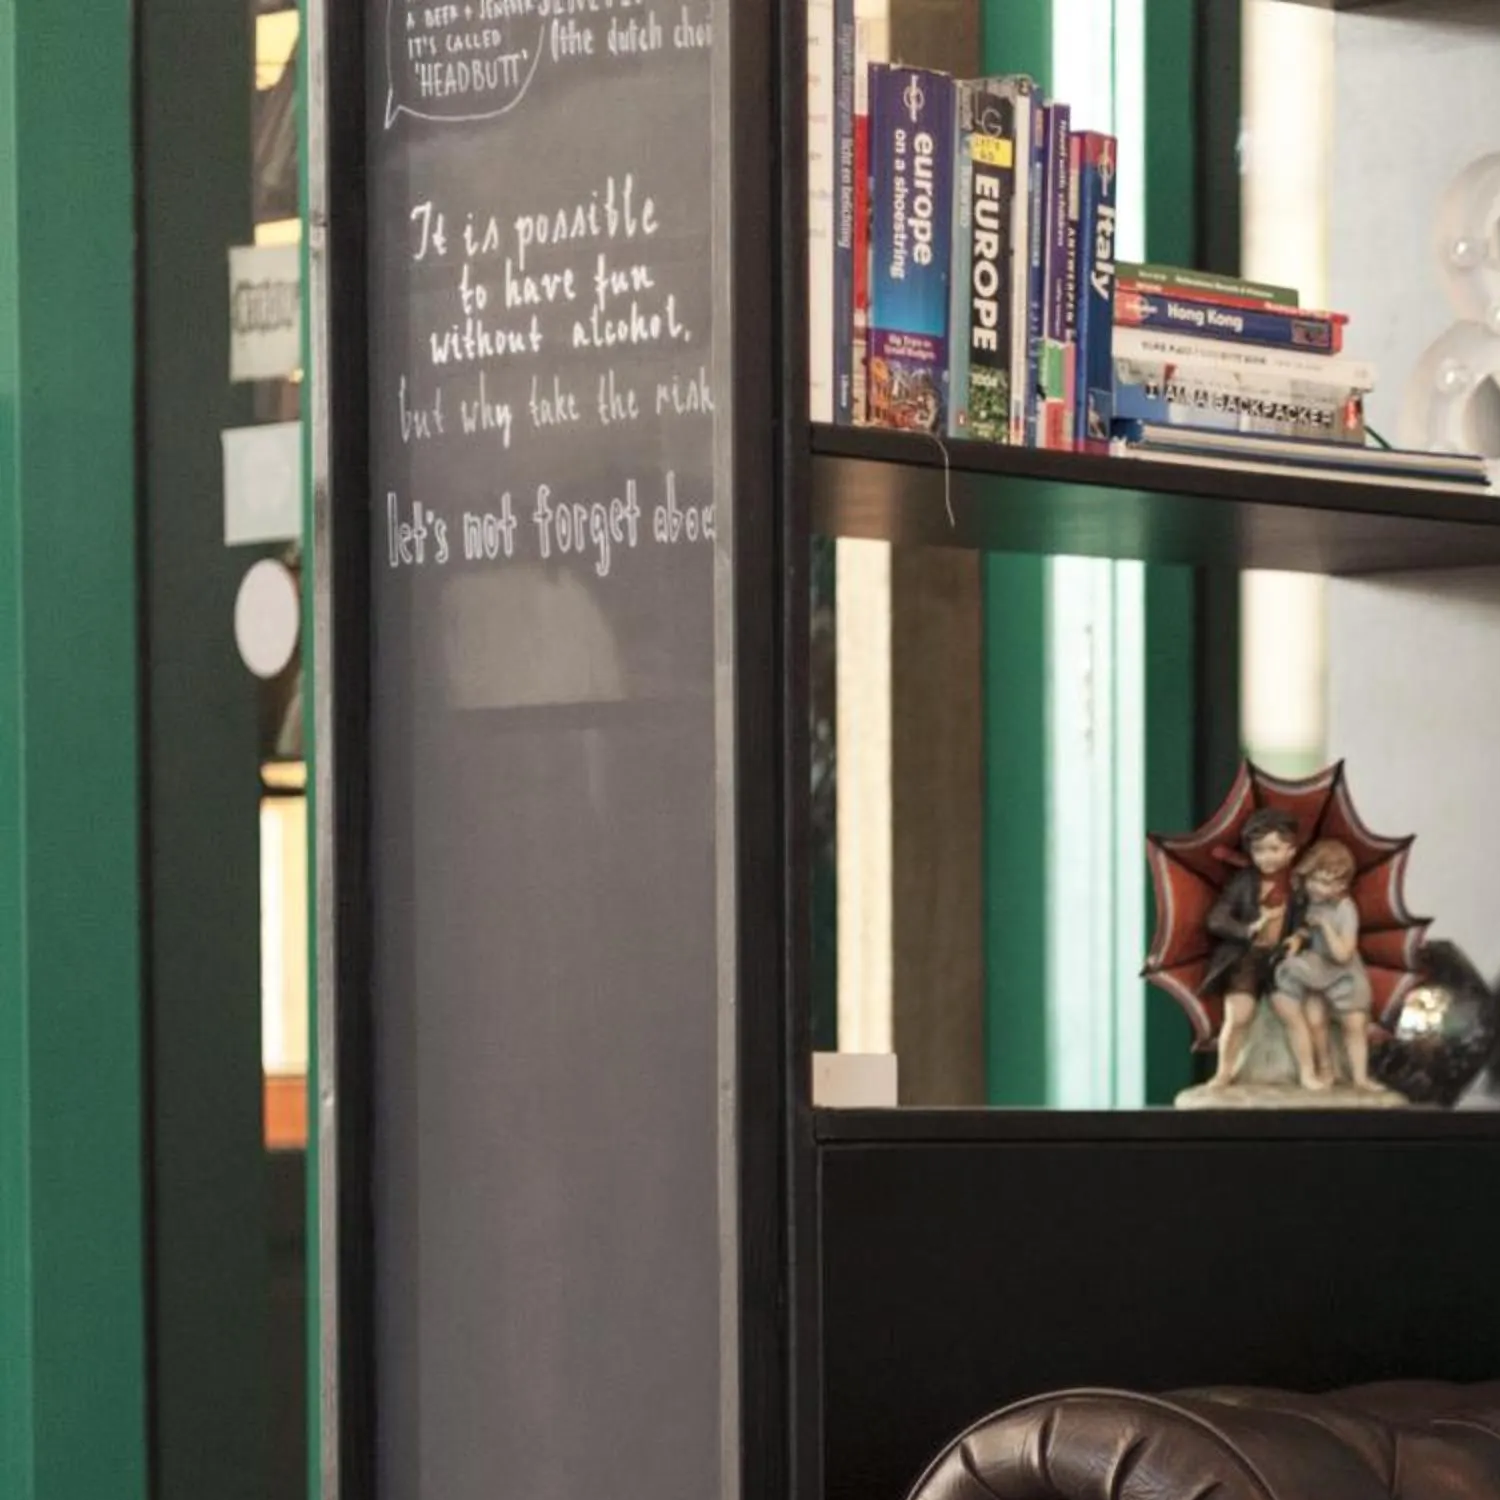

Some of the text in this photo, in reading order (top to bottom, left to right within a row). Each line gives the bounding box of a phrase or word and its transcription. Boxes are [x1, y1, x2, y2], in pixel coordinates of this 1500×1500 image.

[408, 28, 501, 60] IT'S CALLED
[424, 5, 458, 28] BEER
[608, 10, 663, 55] dutch
[410, 173, 659, 271] It is possible
[890, 128, 909, 280] on a shoestring
[908, 132, 934, 266] europe
[459, 253, 655, 315] to have fun
[972, 173, 1000, 352] EUROPE
[1091, 205, 1116, 300] Italy
[430, 313, 544, 364] without
[1167, 302, 1204, 328] Hong
[1207, 308, 1244, 333] Kong
[400, 374, 445, 443] but
[460, 369, 513, 449] why
[529, 374, 580, 427] take
[598, 368, 639, 426] the
[463, 491, 518, 560] not
[533, 479, 641, 576] forget
